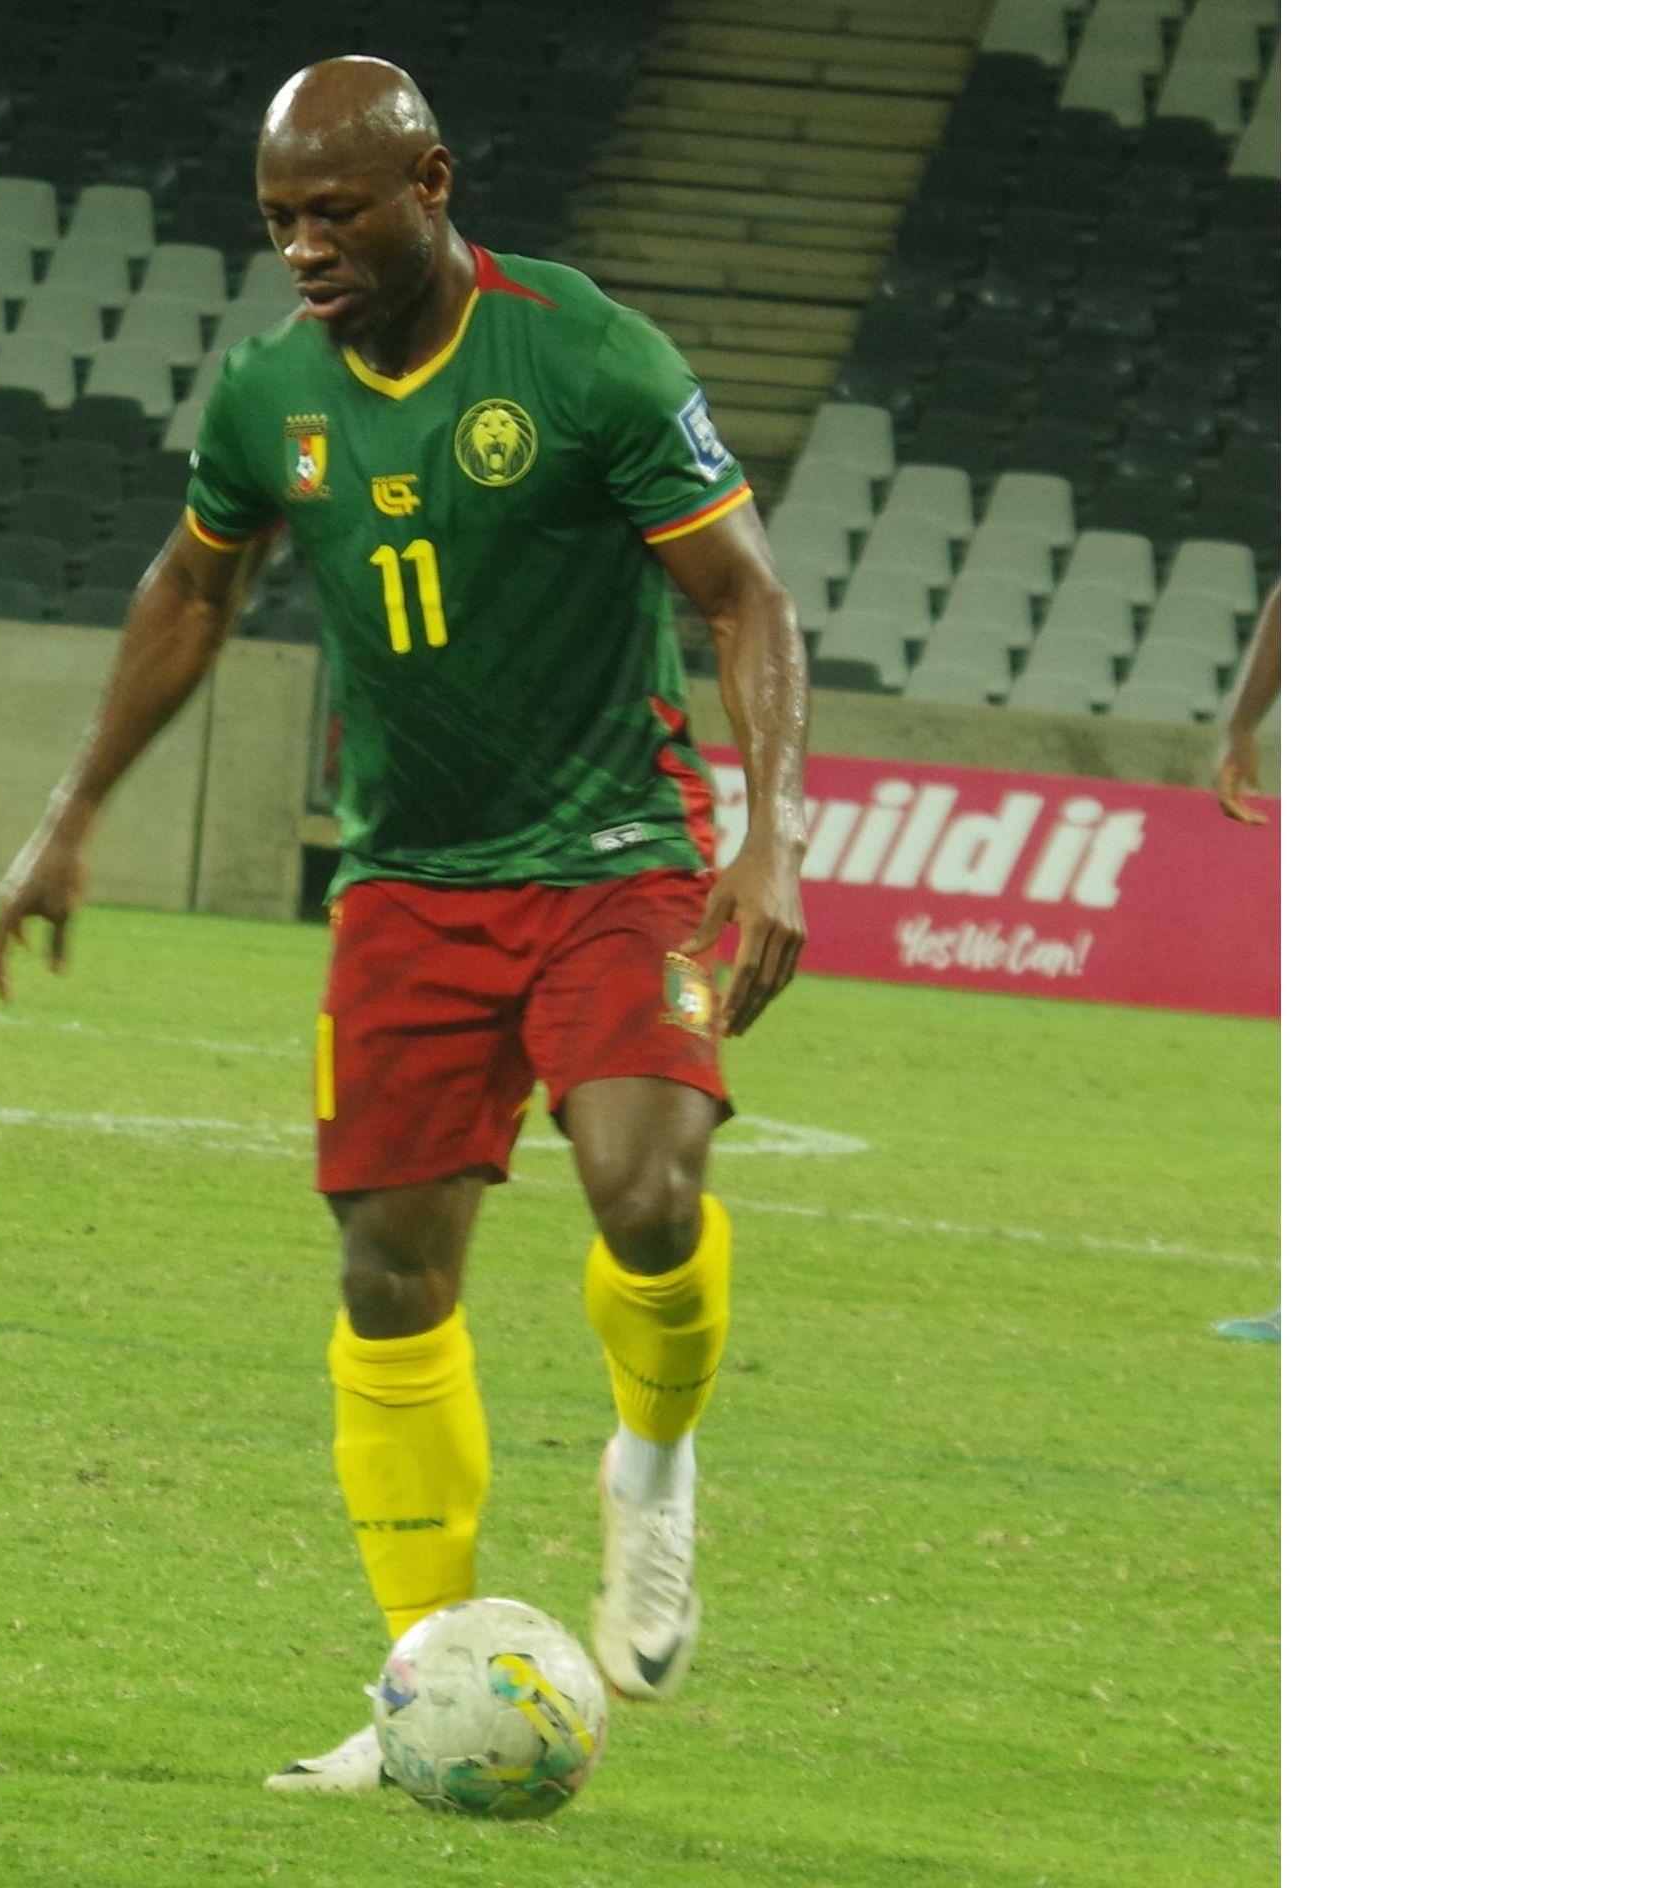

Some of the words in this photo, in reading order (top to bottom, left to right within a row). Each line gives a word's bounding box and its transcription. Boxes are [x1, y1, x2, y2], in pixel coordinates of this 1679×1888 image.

[369, 538, 448, 654] 11
[1026, 798, 1146, 909] it
[898, 914, 956, 970] Yes
[1008, 922, 1094, 979] Can!
